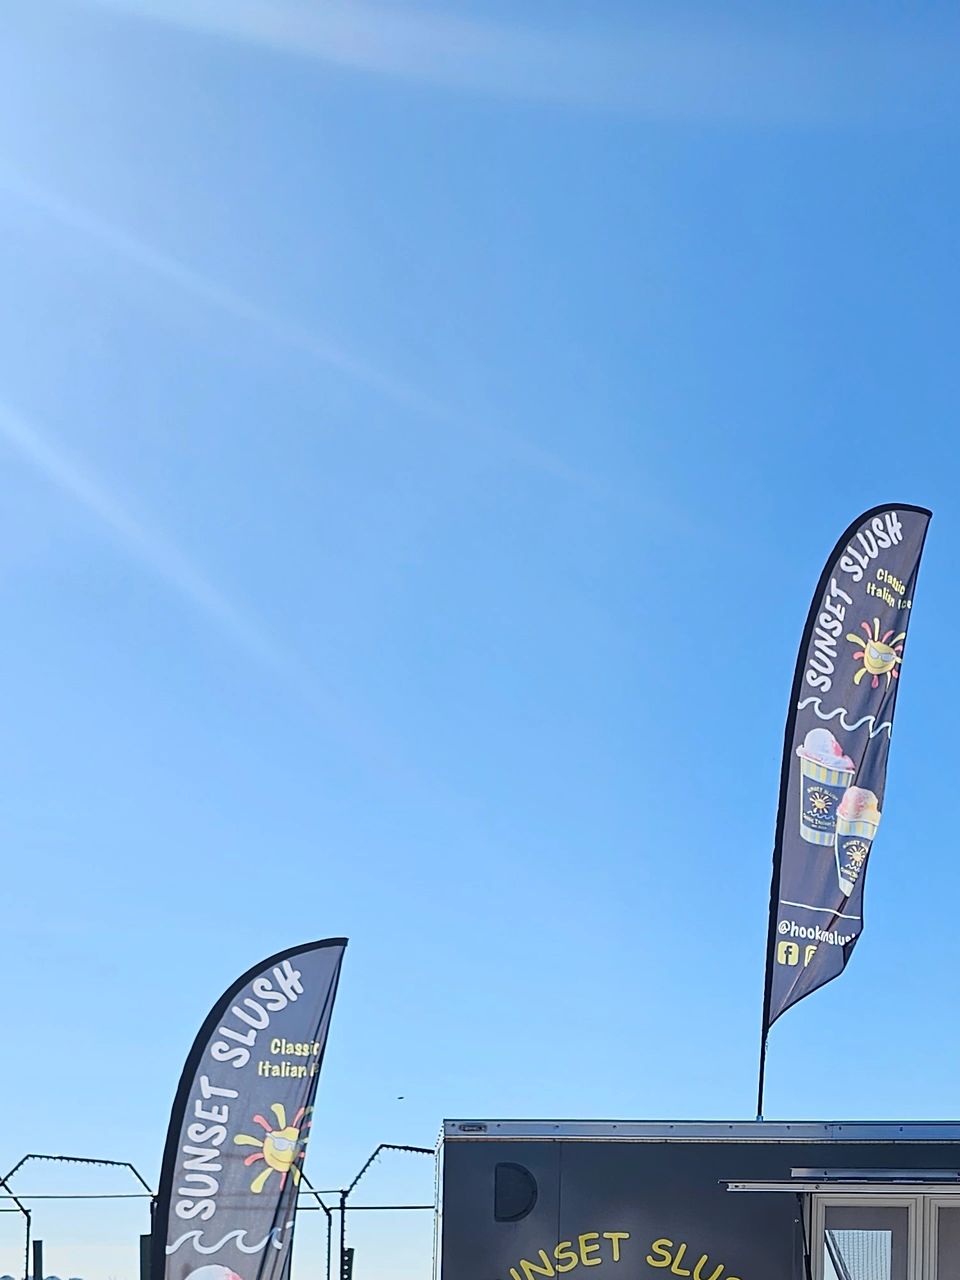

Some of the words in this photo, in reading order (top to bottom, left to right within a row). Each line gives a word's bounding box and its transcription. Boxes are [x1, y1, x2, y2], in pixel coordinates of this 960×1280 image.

[806, 577, 853, 693] SUNSET
[839, 511, 904, 583] SLUSH
[175, 1075, 239, 1221] SUNSET
[210, 959, 304, 1069] SLUSH
[257, 1060, 307, 1078] Italian
